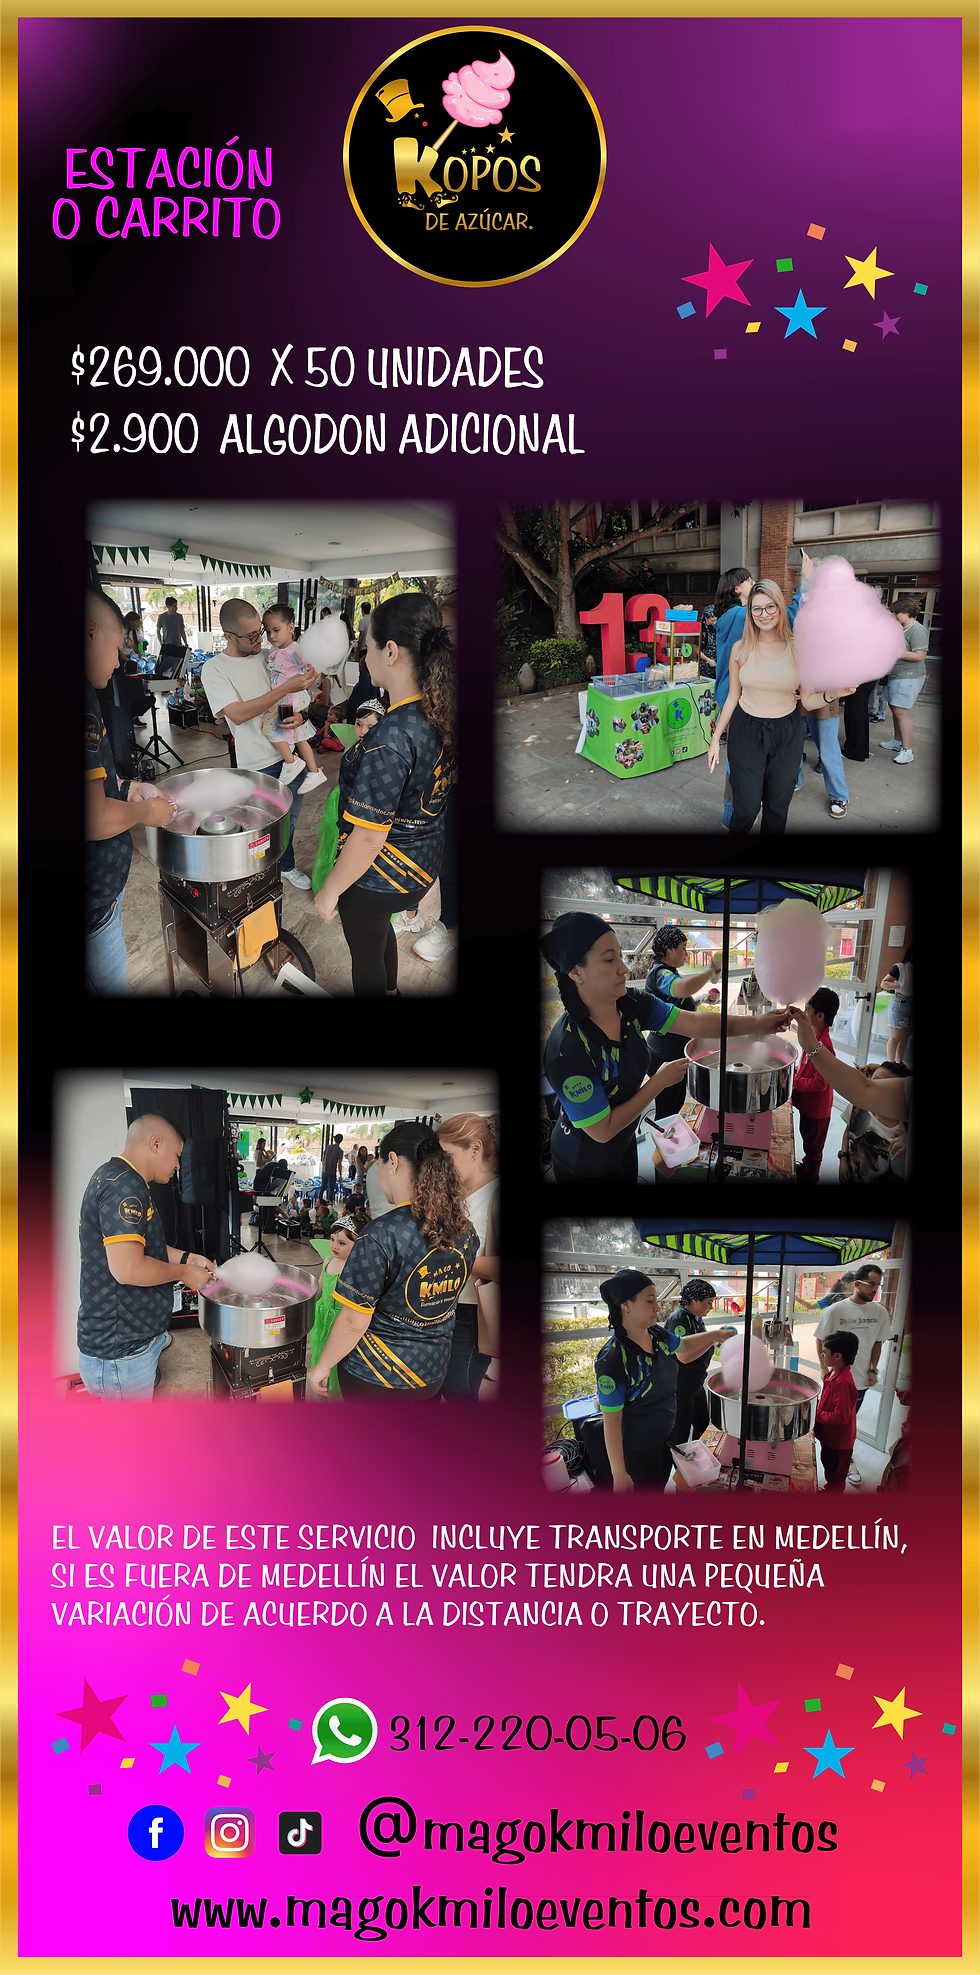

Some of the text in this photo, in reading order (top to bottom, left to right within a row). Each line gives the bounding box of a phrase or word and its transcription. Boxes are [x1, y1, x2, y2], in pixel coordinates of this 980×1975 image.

[66, 136, 273, 190] ESTACIÓN
[393, 136, 542, 197] KOPOS
[52, 196, 281, 240] O CARRITO
[425, 207, 533, 232] DE AZÚCAR.
[71, 343, 544, 389] $269.000 X 50 UNIDADES
[71, 410, 585, 456] $2.900 ALGODON ADICIONAL
[419, 1277, 461, 1299] KMILO
[52, 1517, 908, 1555] EL VALOR DE ESTE SERVICIO INCLUYE TRANSPORTE EN MEDELLÍN,
[50, 1555, 825, 1594] SI ES FUERA DE MEDELLÍN EL VALOR TENDRA UNA PEQUEÑA
[51, 1594, 765, 1627] VARIACIÓN DE ACUERDO A LA DISTANCIA O TRAYECTO.
[389, 1715, 686, 1752] 312-220-05-06
[359, 1796, 838, 1865] @magokmiloeventos
[170, 1885, 811, 1942] www.magokmiloeventos.com
